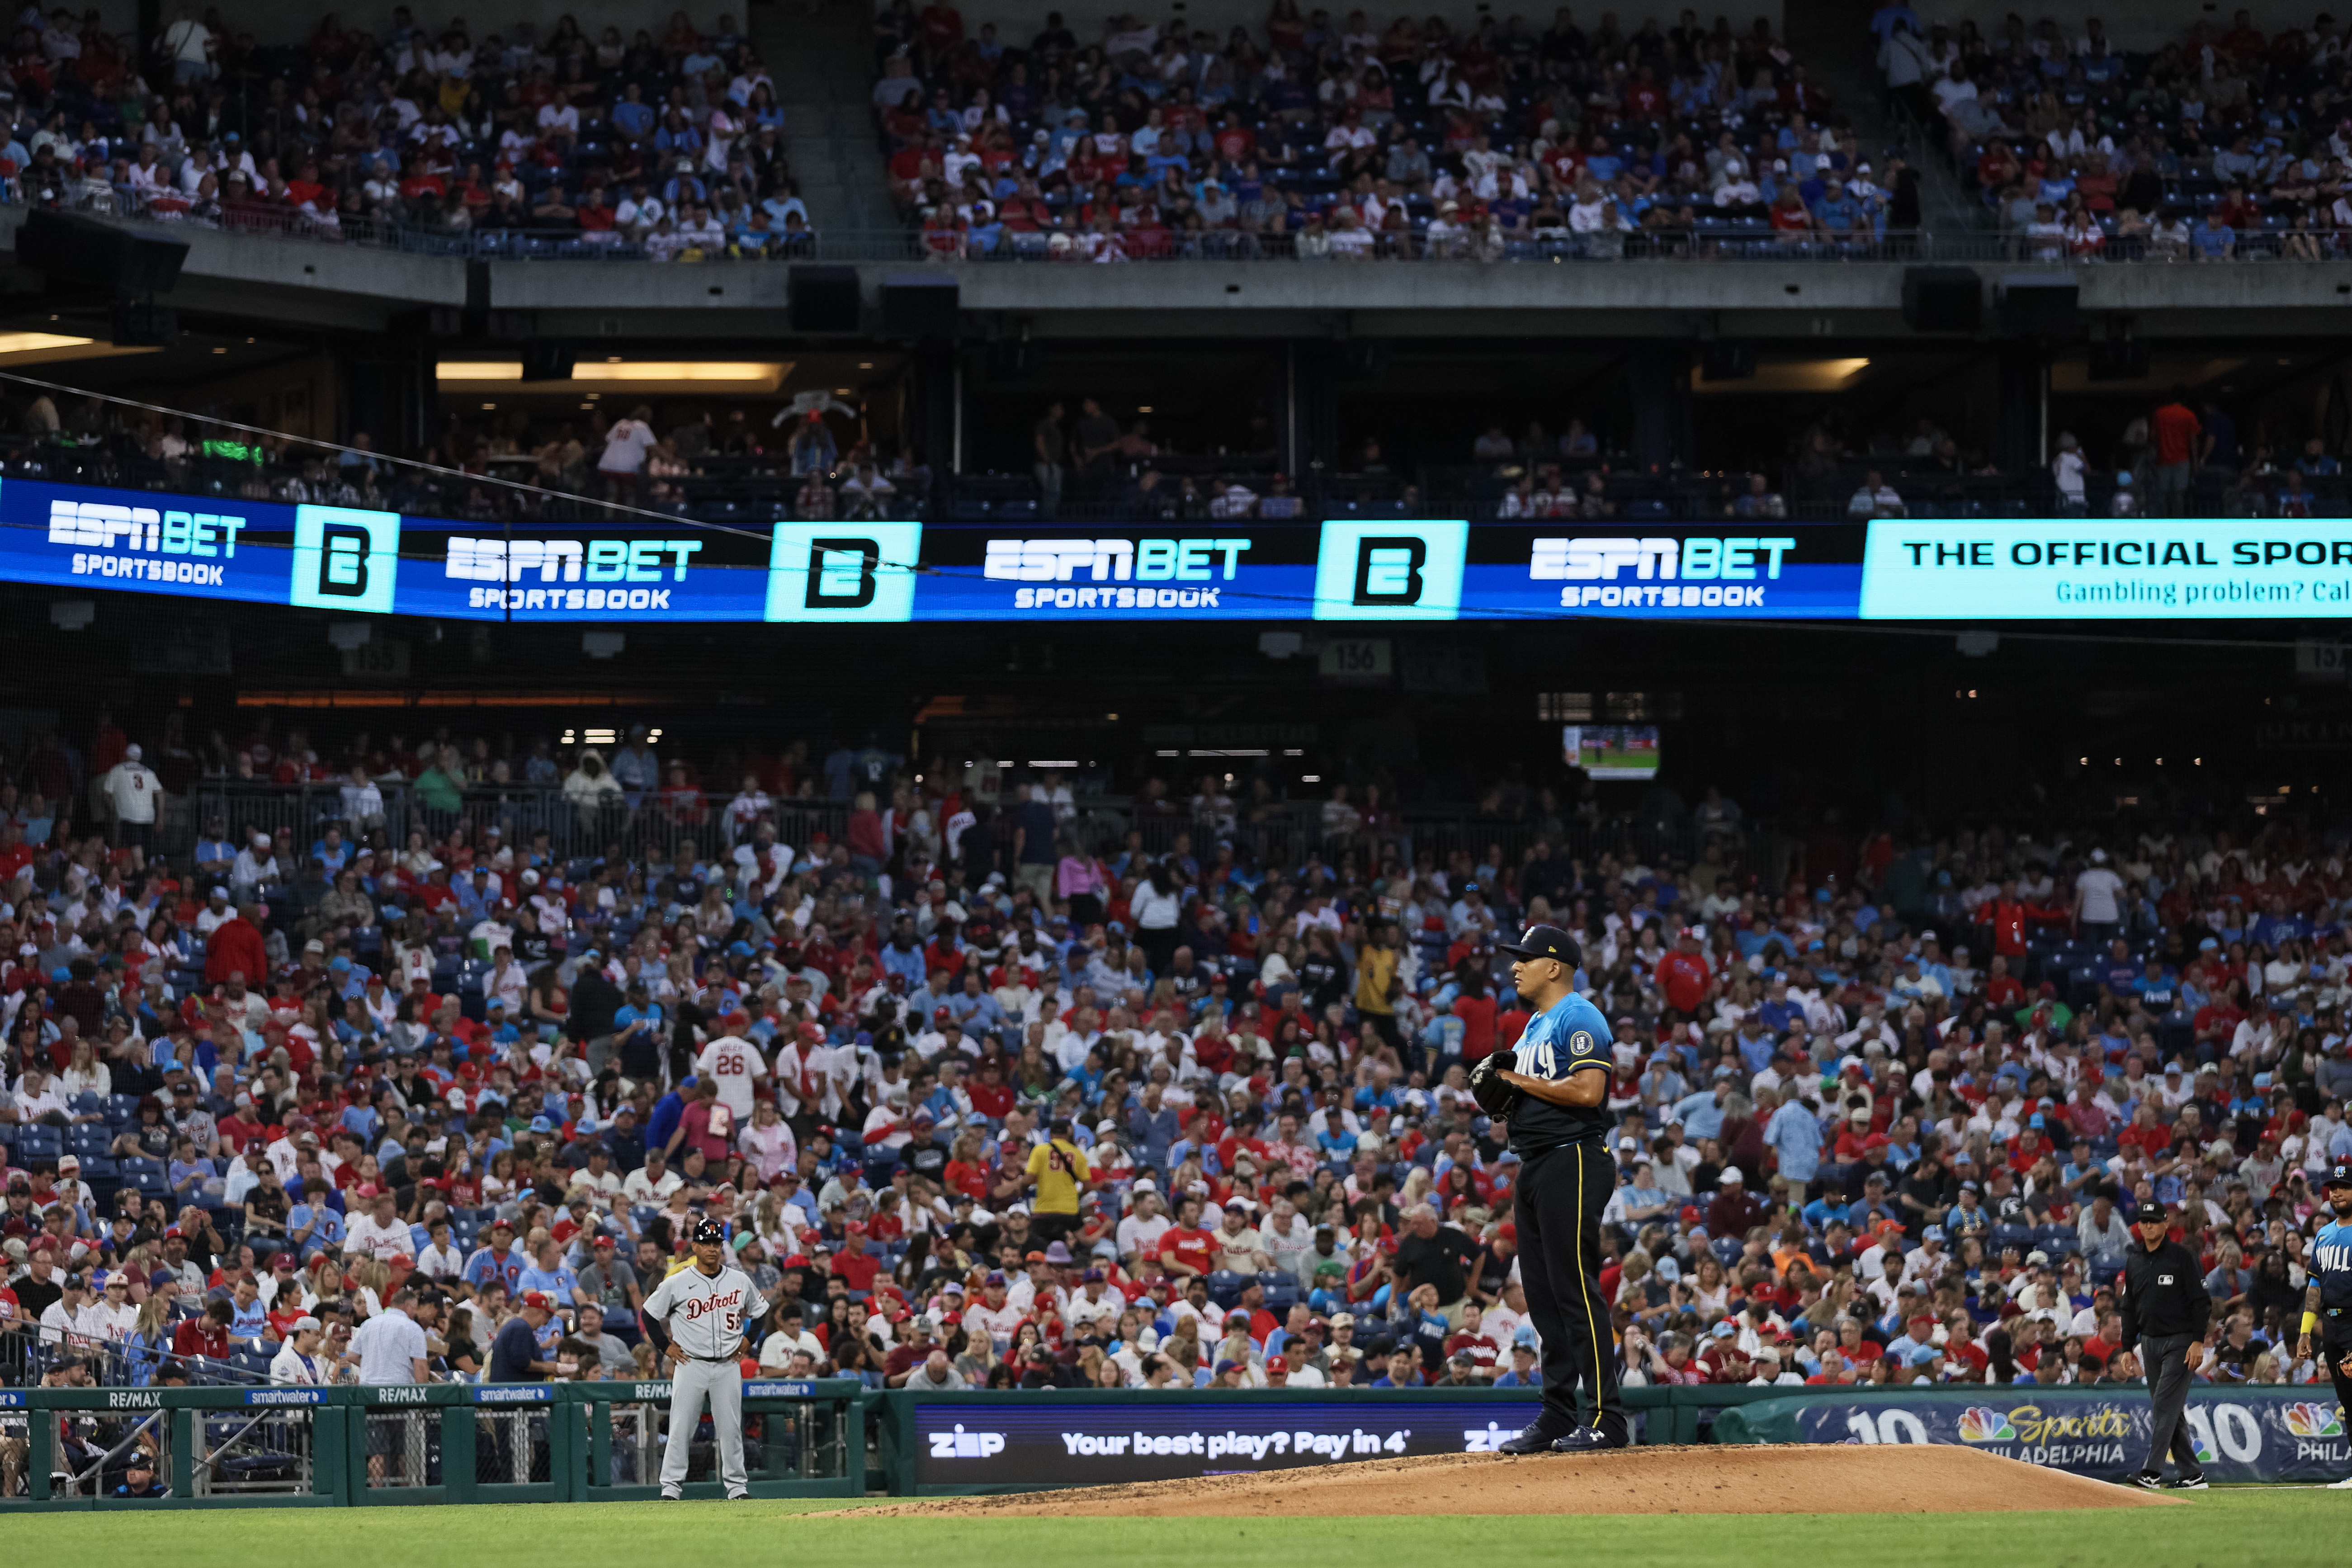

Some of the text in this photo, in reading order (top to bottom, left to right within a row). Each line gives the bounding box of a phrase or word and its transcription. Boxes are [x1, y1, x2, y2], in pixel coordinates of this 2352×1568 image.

[48, 500, 246, 558] ESPN BET
[446, 537, 703, 582] ESPN BET
[984, 539, 1252, 581] ESPN BET
[1530, 538, 1796, 580] ESPN BET
[1903, 543, 1994, 565] THE
[2012, 542, 2218, 565] OFFICIAL
[71, 553, 224, 586] SPORTSBOOK
[469, 588, 670, 609] SPORTSBOOK
[1015, 588, 1220, 608] SPORTSBOOK
[1560, 586, 1764, 607] SPORTSBOOK
[2056, 579, 2177, 607] Gambling
[2186, 579, 2305, 606] problem?
[717, 1054, 744, 1075] 26
[686, 1288, 742, 1320] Detroit
[109, 1392, 161, 1407] RE/MAX
[252, 1389, 310, 1404] smartwater
[379, 1386, 427, 1403] RE/MAX
[480, 1386, 536, 1402] smartwater
[635, 1383, 672, 1399] RE/MA
[748, 1383, 801, 1396] smartwater
[1464, 1421, 1523, 1453] zi
[2008, 1404, 2130, 1449] Sports
[1061, 1432, 1130, 1456] Your
[1133, 1431, 1204, 1455] best
[1208, 1431, 1290, 1460] play?
[1294, 1431, 1351, 1460] Pay
[1353, 1429, 1381, 1454] in
